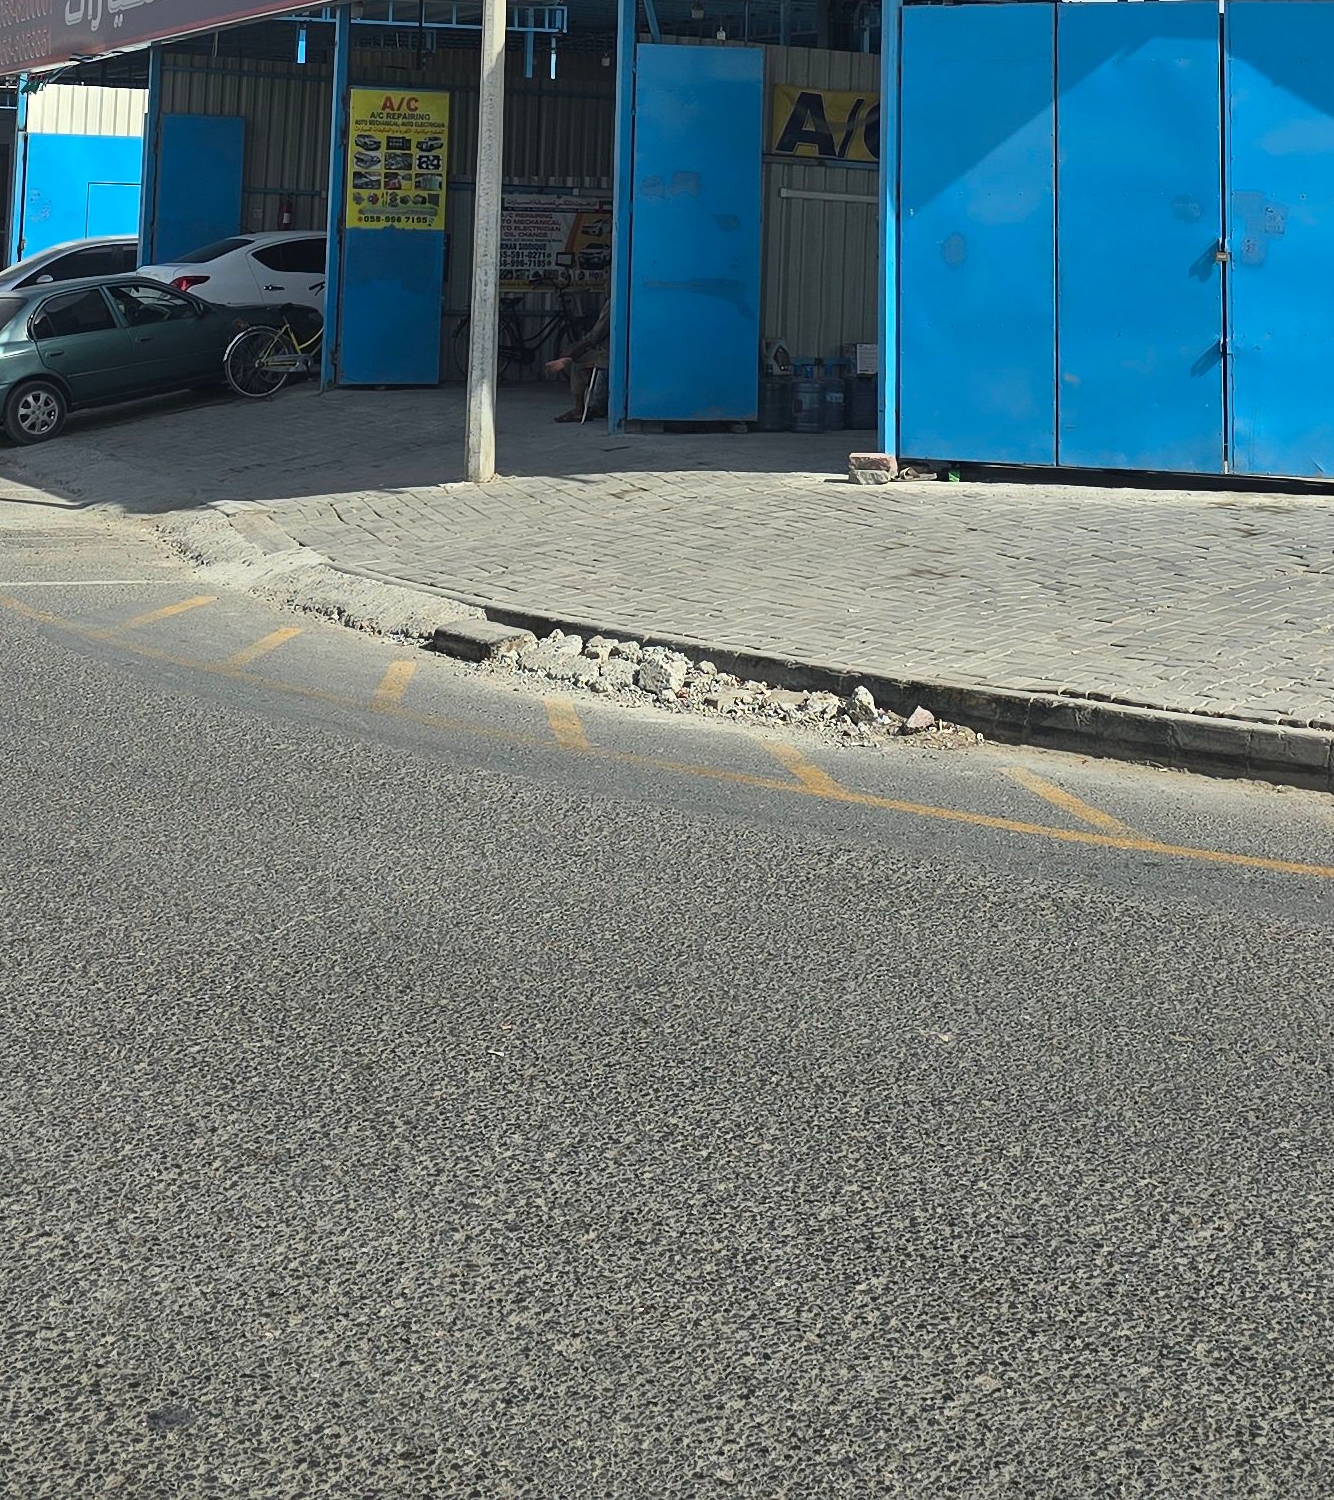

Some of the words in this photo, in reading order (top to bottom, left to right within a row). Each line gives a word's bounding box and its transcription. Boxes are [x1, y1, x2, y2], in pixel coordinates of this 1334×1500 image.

[381, 95, 419, 112] A/C
[370, 111, 384, 119] A/C
[386, 112, 431, 121] REPAIRING
